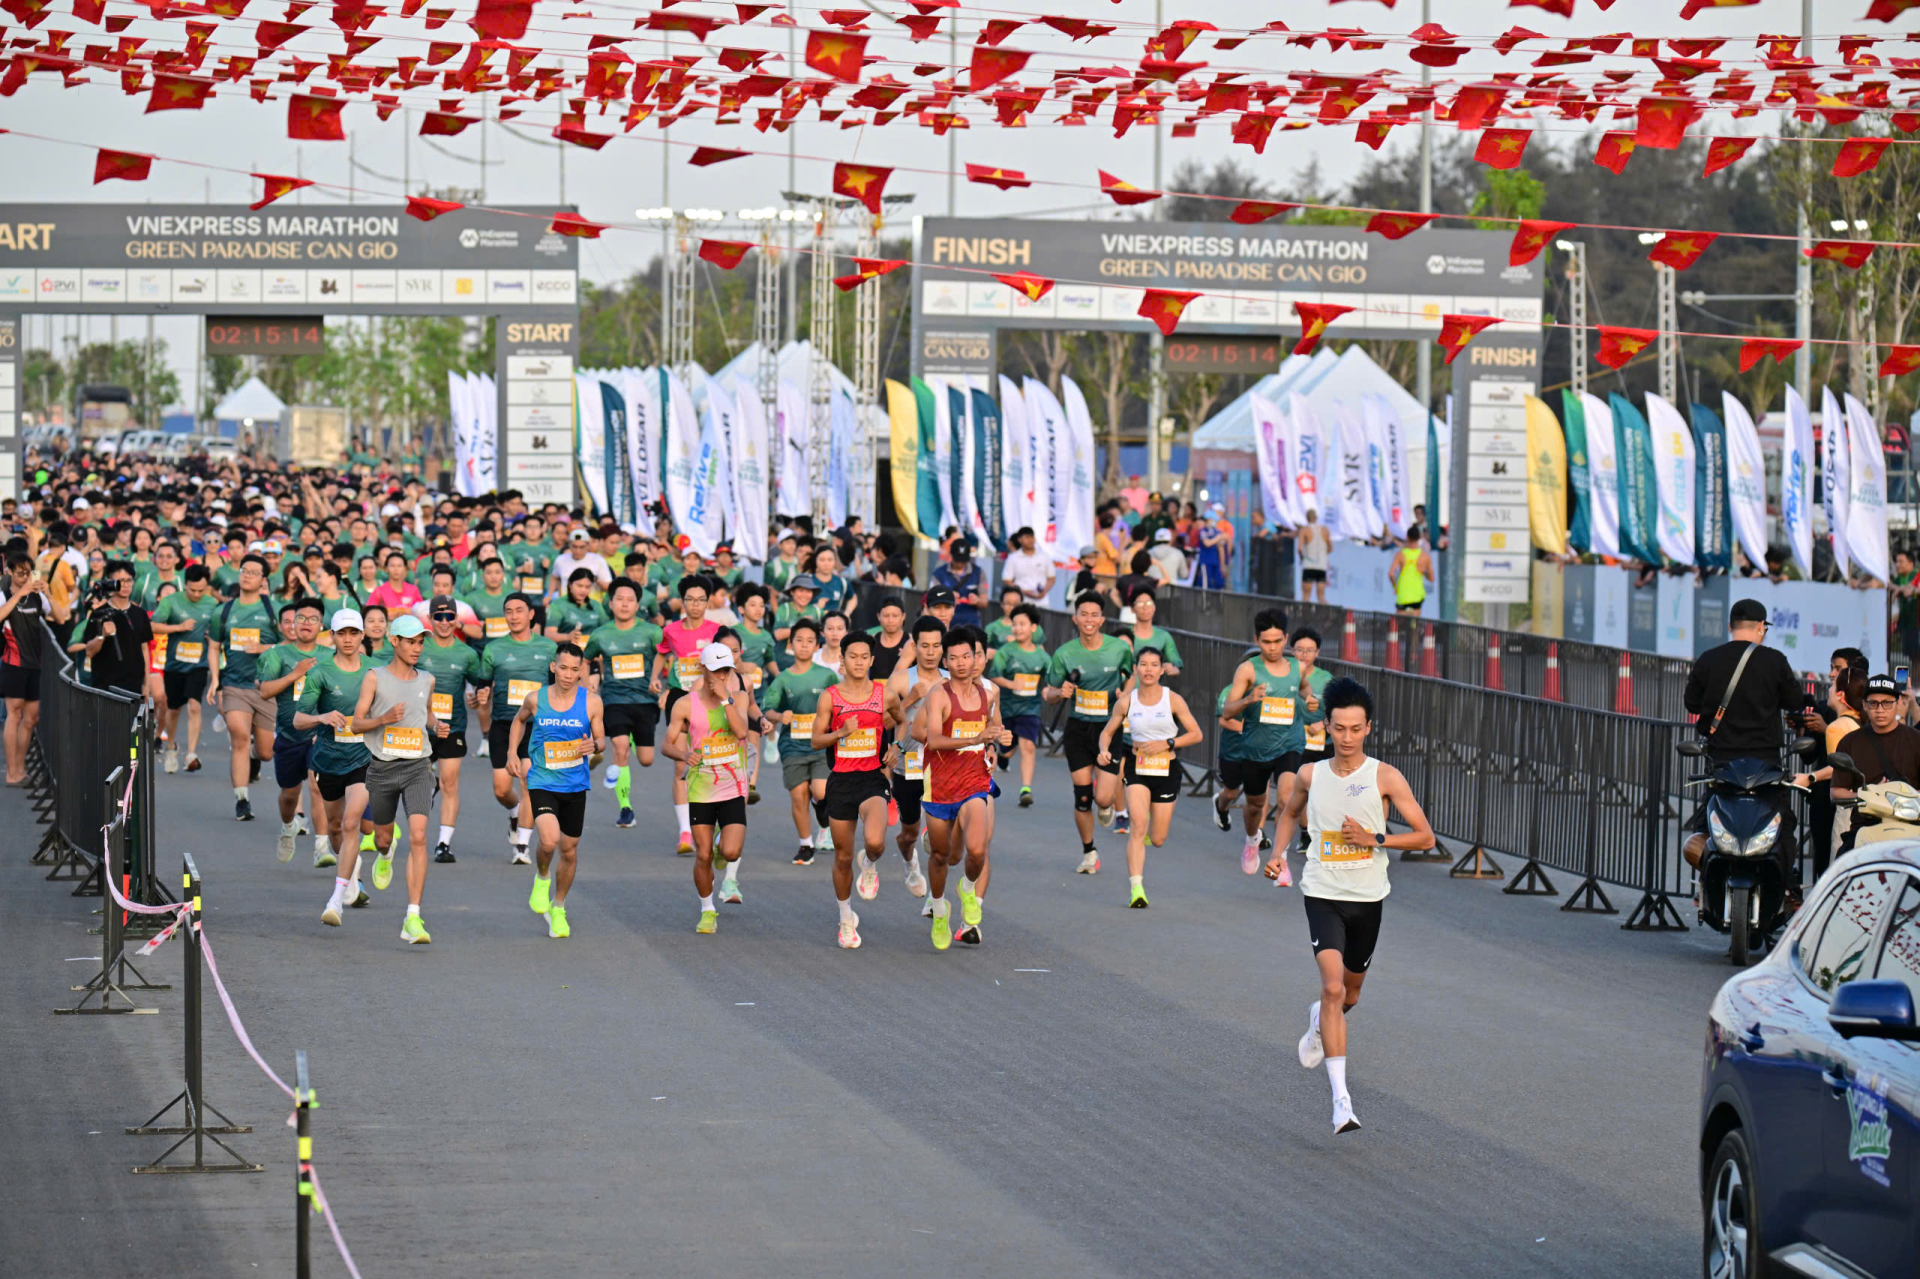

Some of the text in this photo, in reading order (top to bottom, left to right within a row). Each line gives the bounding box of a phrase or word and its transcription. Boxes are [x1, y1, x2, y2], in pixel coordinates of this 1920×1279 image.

[126, 216, 398, 236] VNEXPRESS MARATHON
[125, 241, 398, 260] GREEN PARADISE CAN GIO
[932, 237, 1031, 265] FINISH
[1101, 233, 1368, 260] VNEXPRESS MARATHON
[1100, 258, 1367, 283] GREEN PARADISE CAN GIO
[321, 279, 338, 294] 84
[210, 326, 319, 345] 02:15:14
[506, 323, 573, 343] START
[924, 346, 990, 360] CAN GIO
[1169, 345, 1275, 363] 02:15:14
[1470, 347, 1537, 367] FINISH
[637, 403, 648, 501] VELOSAR
[1300, 434, 1312, 472] PVI
[689, 443, 711, 524] ReVive
[1702, 432, 1714, 554] VNEXPRESS MARATHON
[431, 702, 450, 710] 0134
[394, 736, 421, 746] 50542
[847, 738, 875, 747] 50056
[1324, 841, 1332, 855] M
